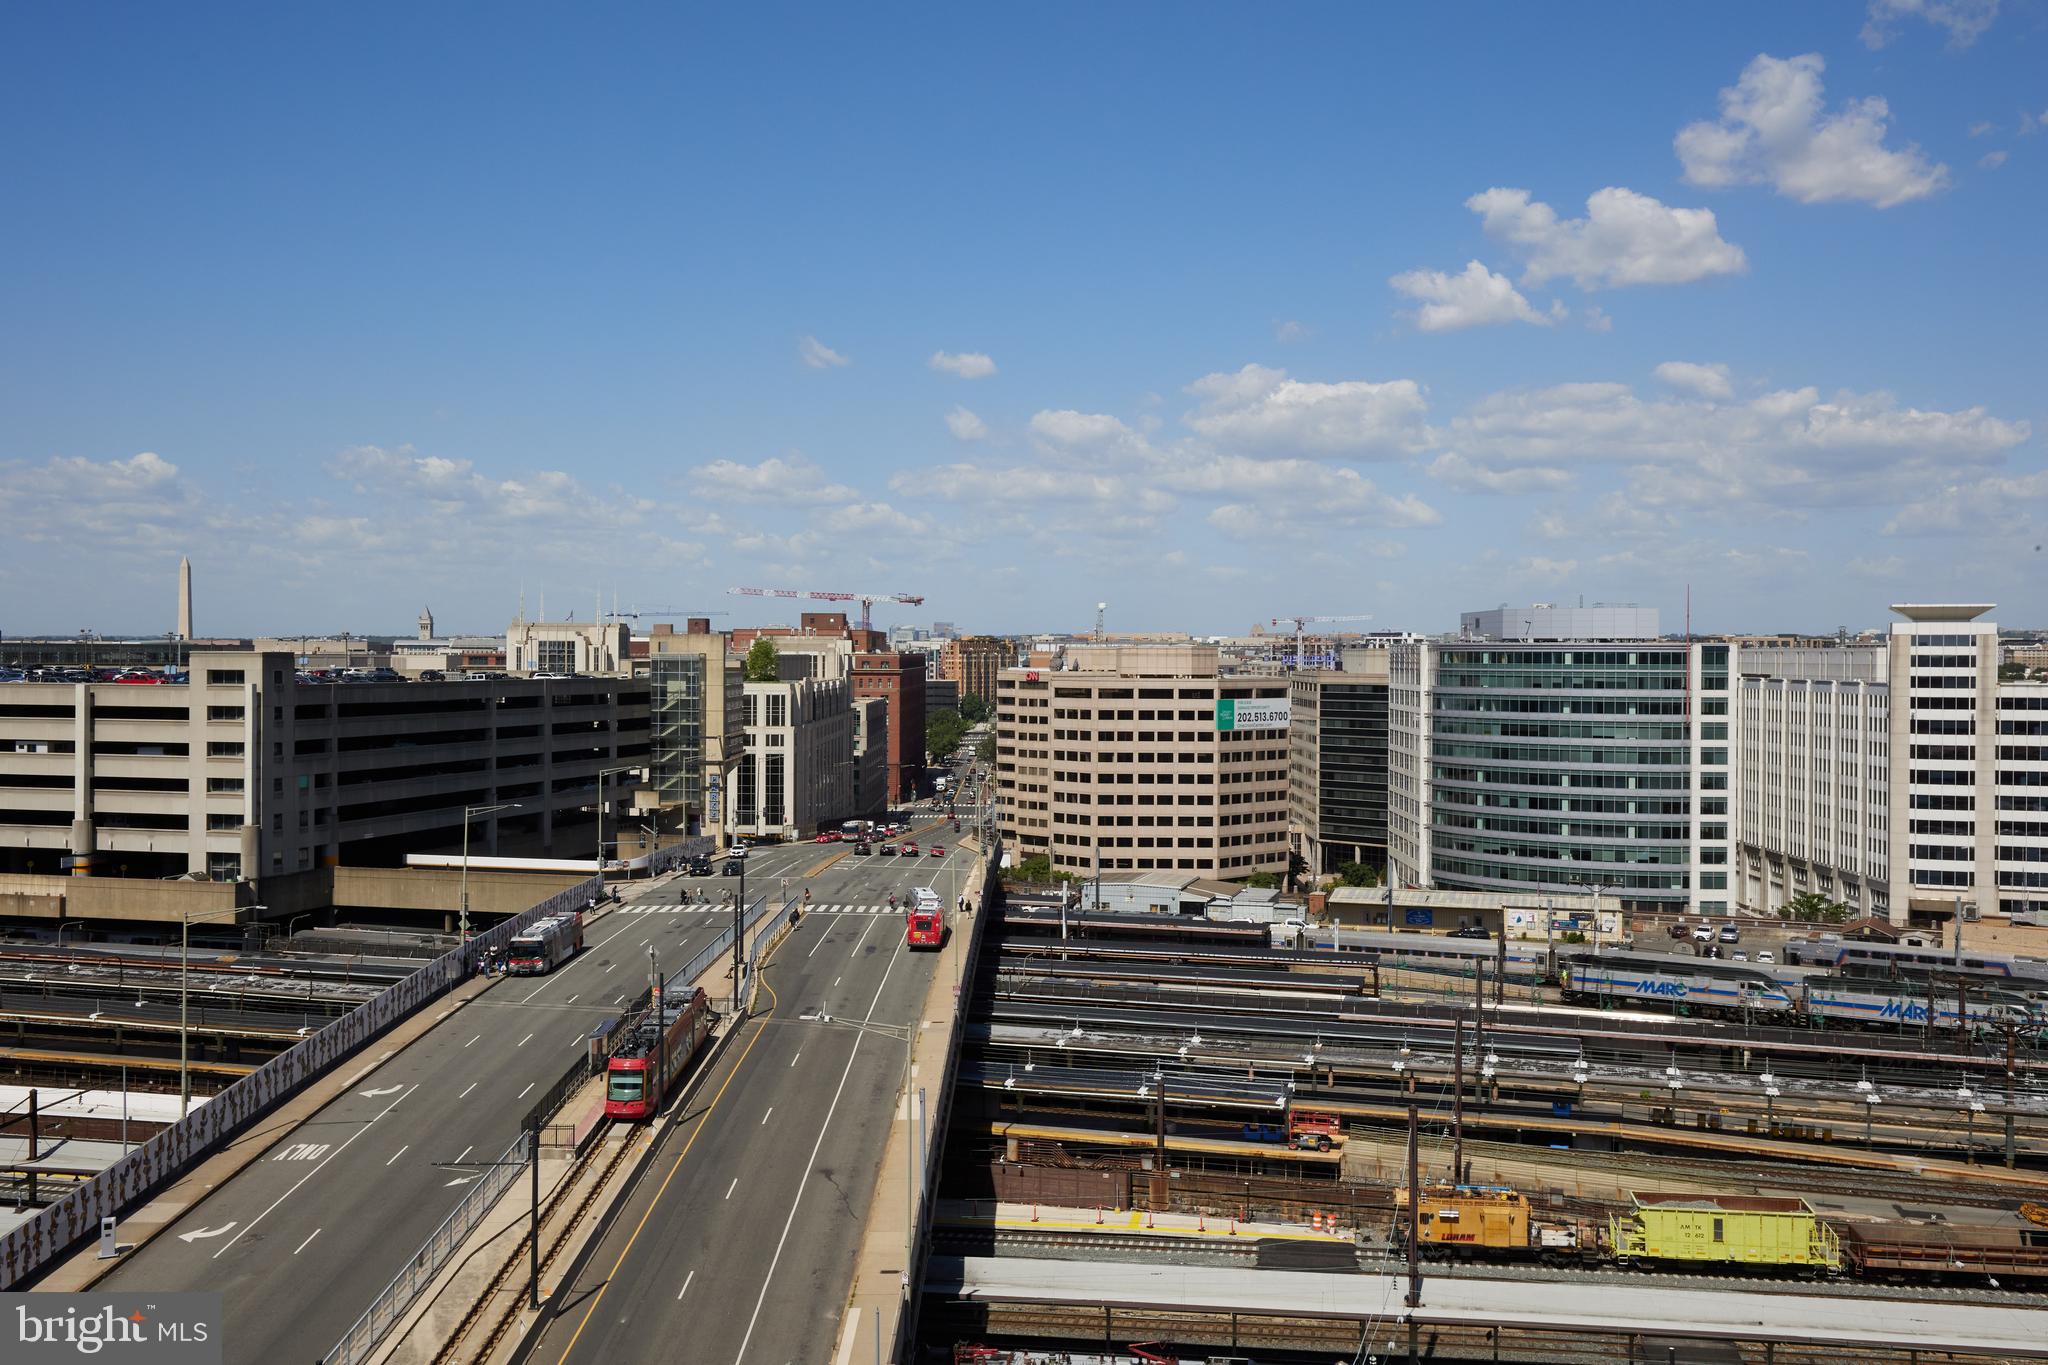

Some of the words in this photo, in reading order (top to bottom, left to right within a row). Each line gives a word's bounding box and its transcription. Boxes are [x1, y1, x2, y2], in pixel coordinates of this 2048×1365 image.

[1026, 671, 1039, 681] CNN
[1237, 711, 1288, 722] 202.513.6700
[1635, 980, 1688, 997] MARC
[272, 1144, 331, 1161] ONLY
